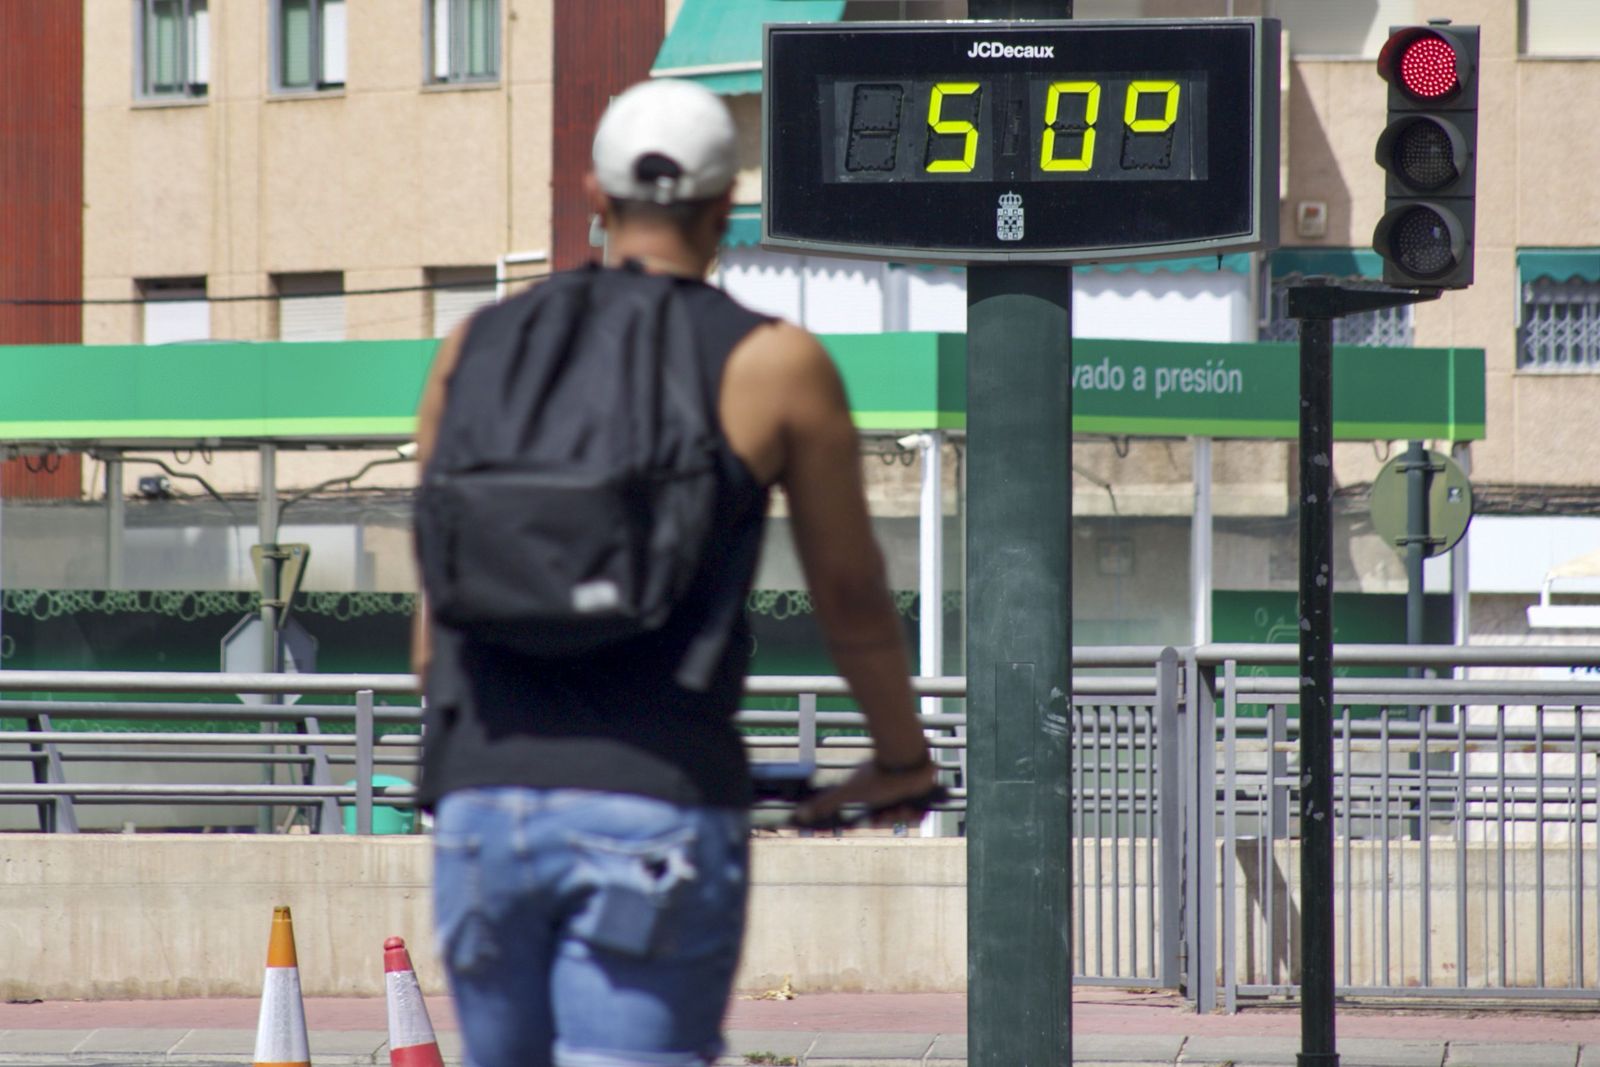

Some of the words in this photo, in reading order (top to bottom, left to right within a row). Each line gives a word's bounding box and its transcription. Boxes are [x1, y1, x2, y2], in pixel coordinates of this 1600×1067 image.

[967, 41, 1055, 59] JCDecaux
[1132, 366, 1146, 391] a
[1155, 359, 1242, 399] presión
